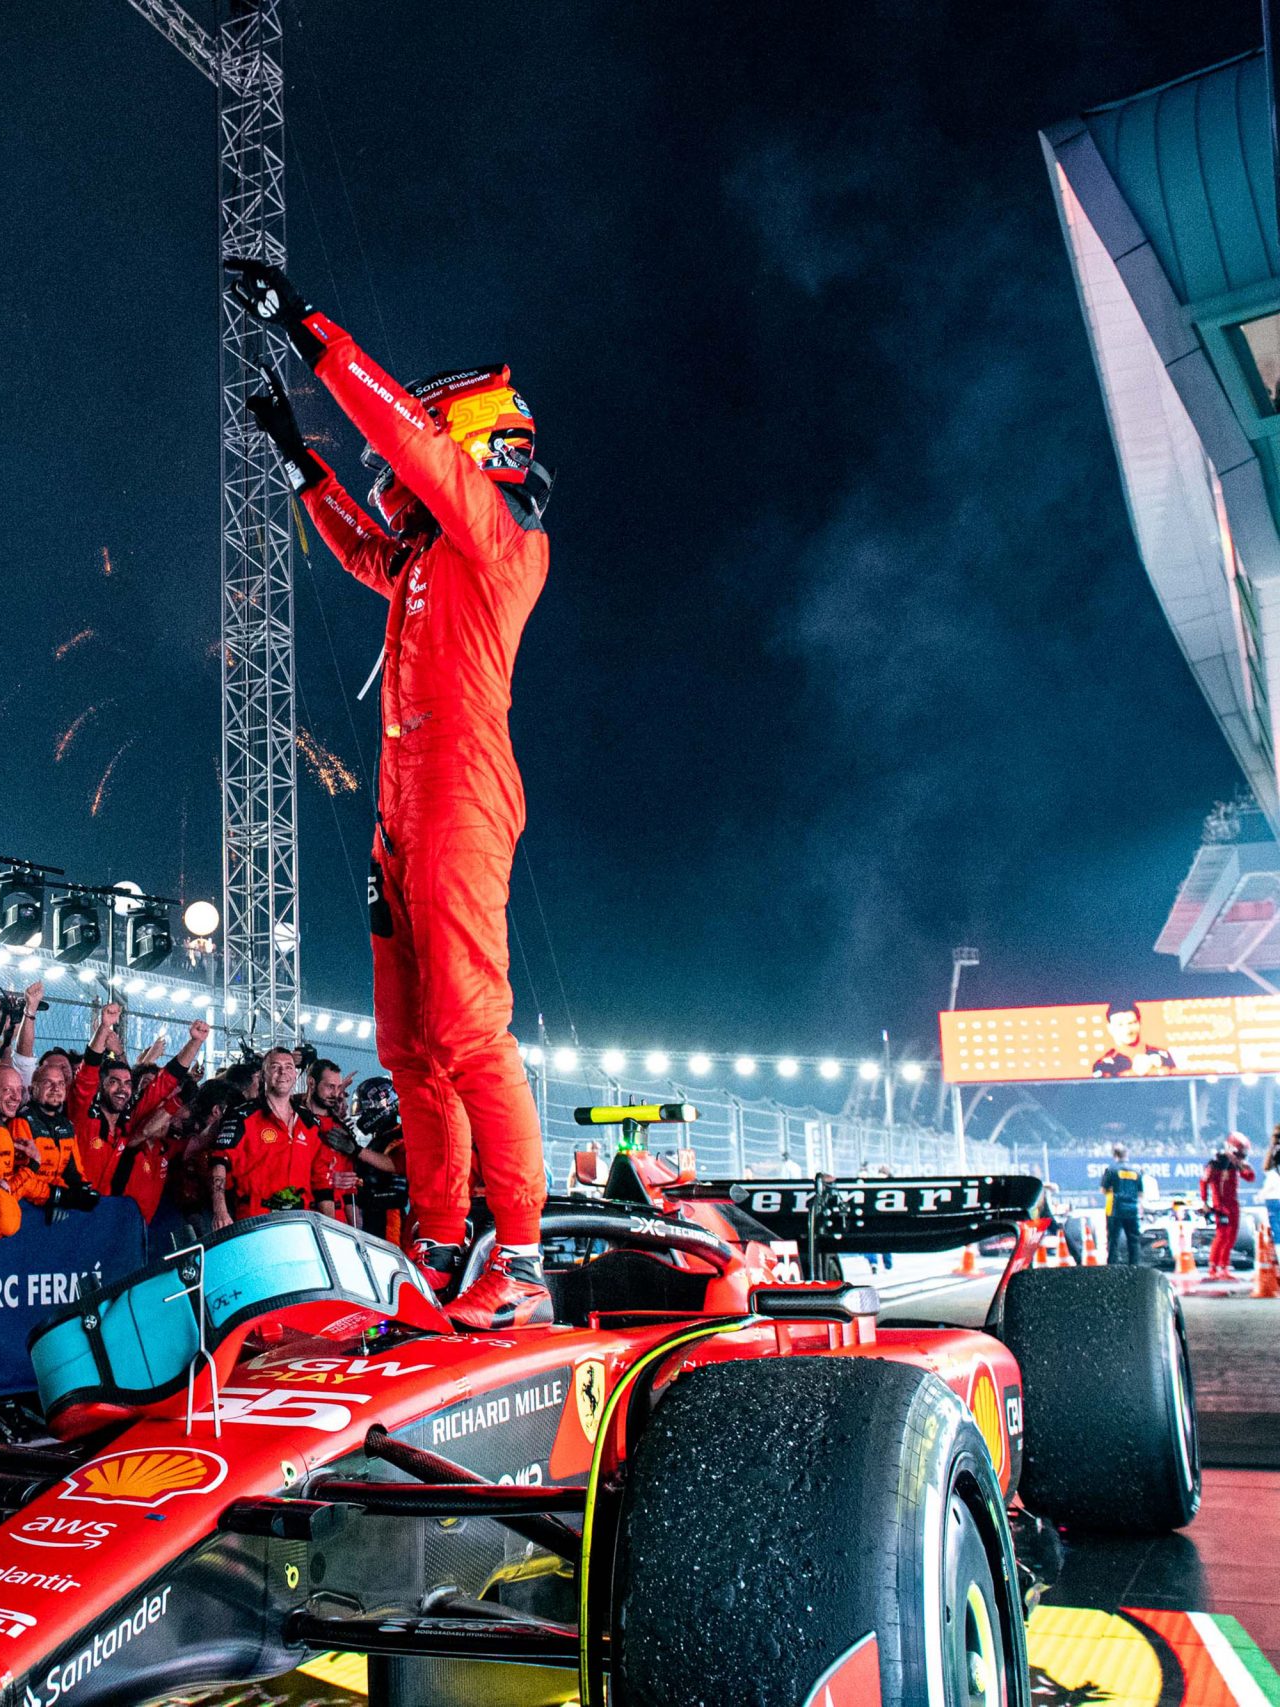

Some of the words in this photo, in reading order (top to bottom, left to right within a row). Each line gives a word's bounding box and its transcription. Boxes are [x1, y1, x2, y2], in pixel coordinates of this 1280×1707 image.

[347, 361, 394, 403] RICHARD
[394, 401, 426, 430] MILLE
[415, 370, 479, 397] Santander
[448, 372, 491, 391] Bitdefender
[324, 494, 357, 527] RICHARD
[751, 1181, 982, 1214] errari
[629, 1215, 666, 1238] DXC
[246, 1356, 436, 1377] VGW
[249, 1370, 365, 1385] PLAY
[178, 1387, 372, 1432] 55
[432, 1394, 510, 1446] RICHARD
[515, 1380, 563, 1416] MILLE
[22, 1515, 118, 1539] aws
[46, 1585, 172, 1707] Santander
